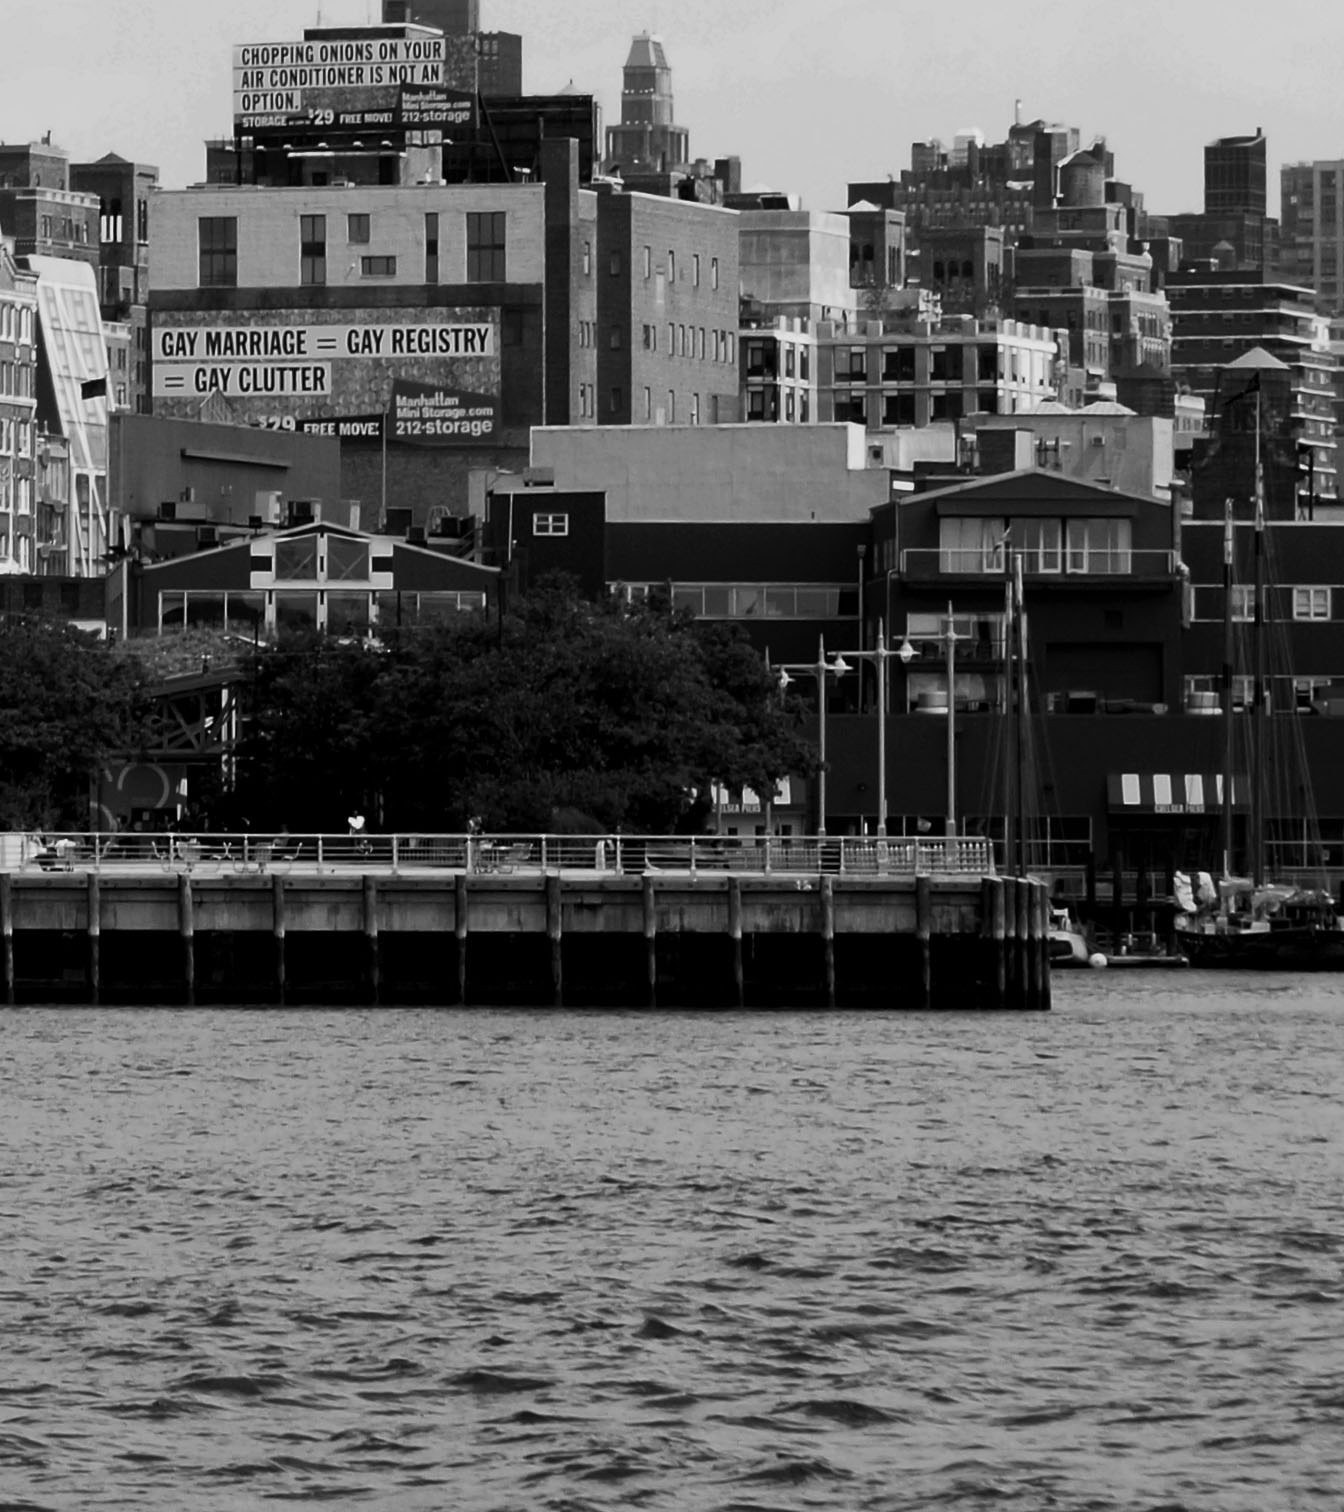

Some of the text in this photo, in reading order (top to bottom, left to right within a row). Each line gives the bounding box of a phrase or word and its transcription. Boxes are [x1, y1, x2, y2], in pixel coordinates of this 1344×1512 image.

[242, 41, 442, 65] CHOPPING ONIONS ON YOUR
[242, 64, 440, 89] AIR CONDITIONER IS NOT AN
[242, 92, 299, 112] OPTION.
[402, 90, 447, 101] Manhattan
[242, 115, 288, 128] STORAGE
[340, 113, 362, 124] FREE
[162, 331, 198, 357] GAY
[206, 330, 307, 356] MARRIAGE
[347, 329, 384, 354] GAY
[392, 327, 489, 353] REGISTRY
[194, 367, 232, 393] GAY
[239, 366, 326, 392] CLUTTER
[395, 391, 459, 407] Manhattan
[396, 407, 494, 420] Mini Storage.com
[304, 423, 336, 436] FREE
[339, 422, 380, 436] MOVE!
